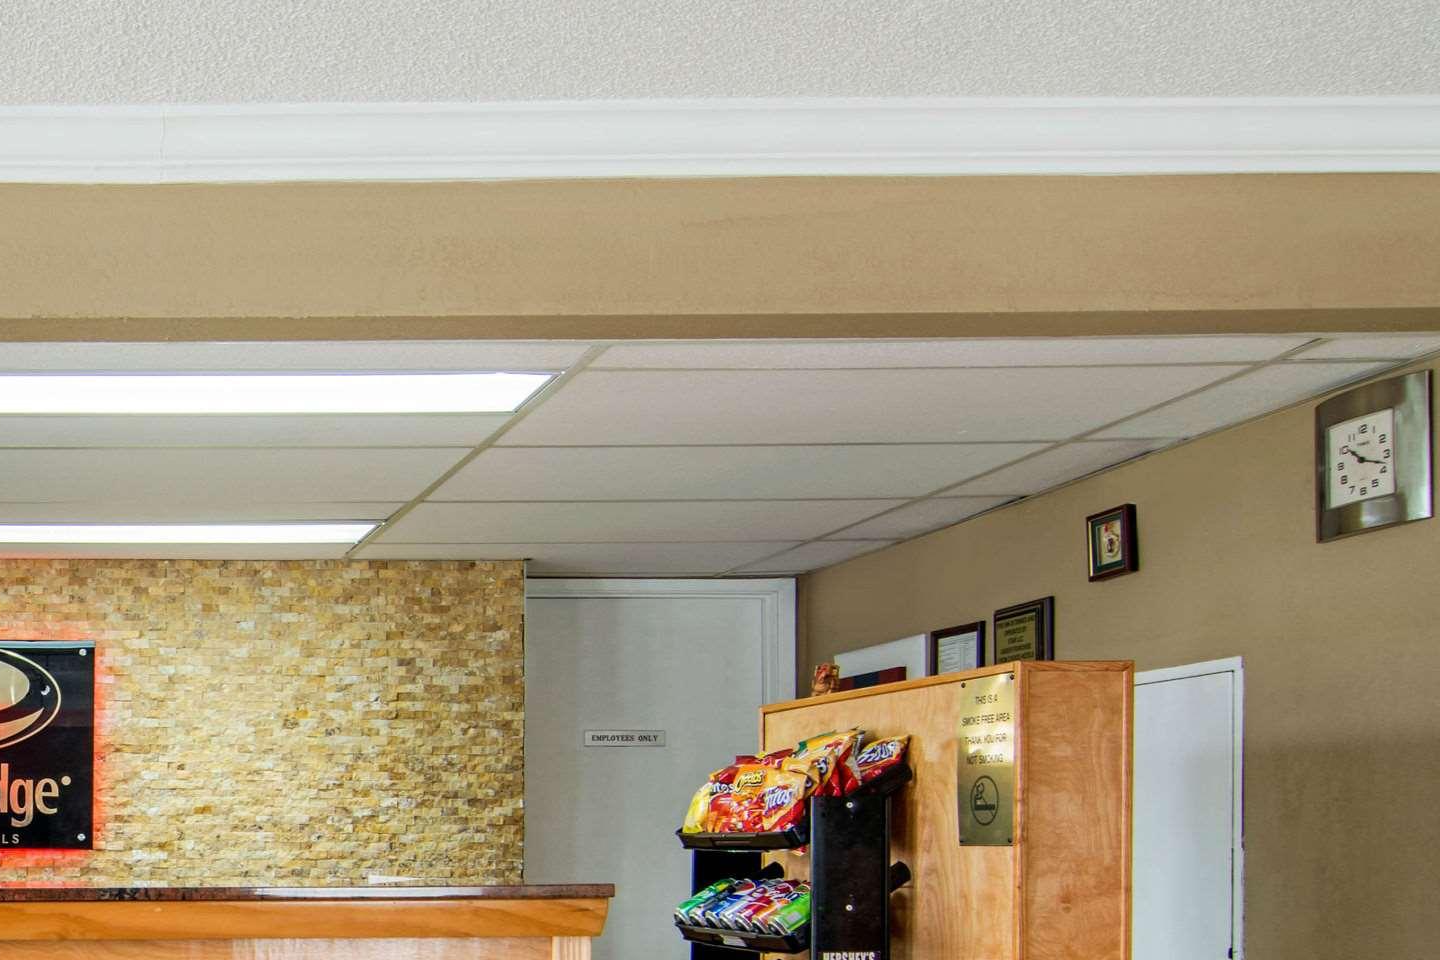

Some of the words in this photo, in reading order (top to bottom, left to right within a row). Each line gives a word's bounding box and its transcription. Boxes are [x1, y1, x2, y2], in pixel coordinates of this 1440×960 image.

[1378, 434, 1387, 444] 2
[1383, 449, 1391, 459] 3
[1379, 465, 1388, 474] 4
[1371, 478, 1380, 488] 5
[1348, 485, 1356, 495] 7
[961, 715, 980, 727] SMOKE
[981, 713, 995, 723] FREE
[996, 712, 1011, 722] AREA
[591, 734, 634, 742] EMPLOYEES
[638, 734, 658, 742] ONLY
